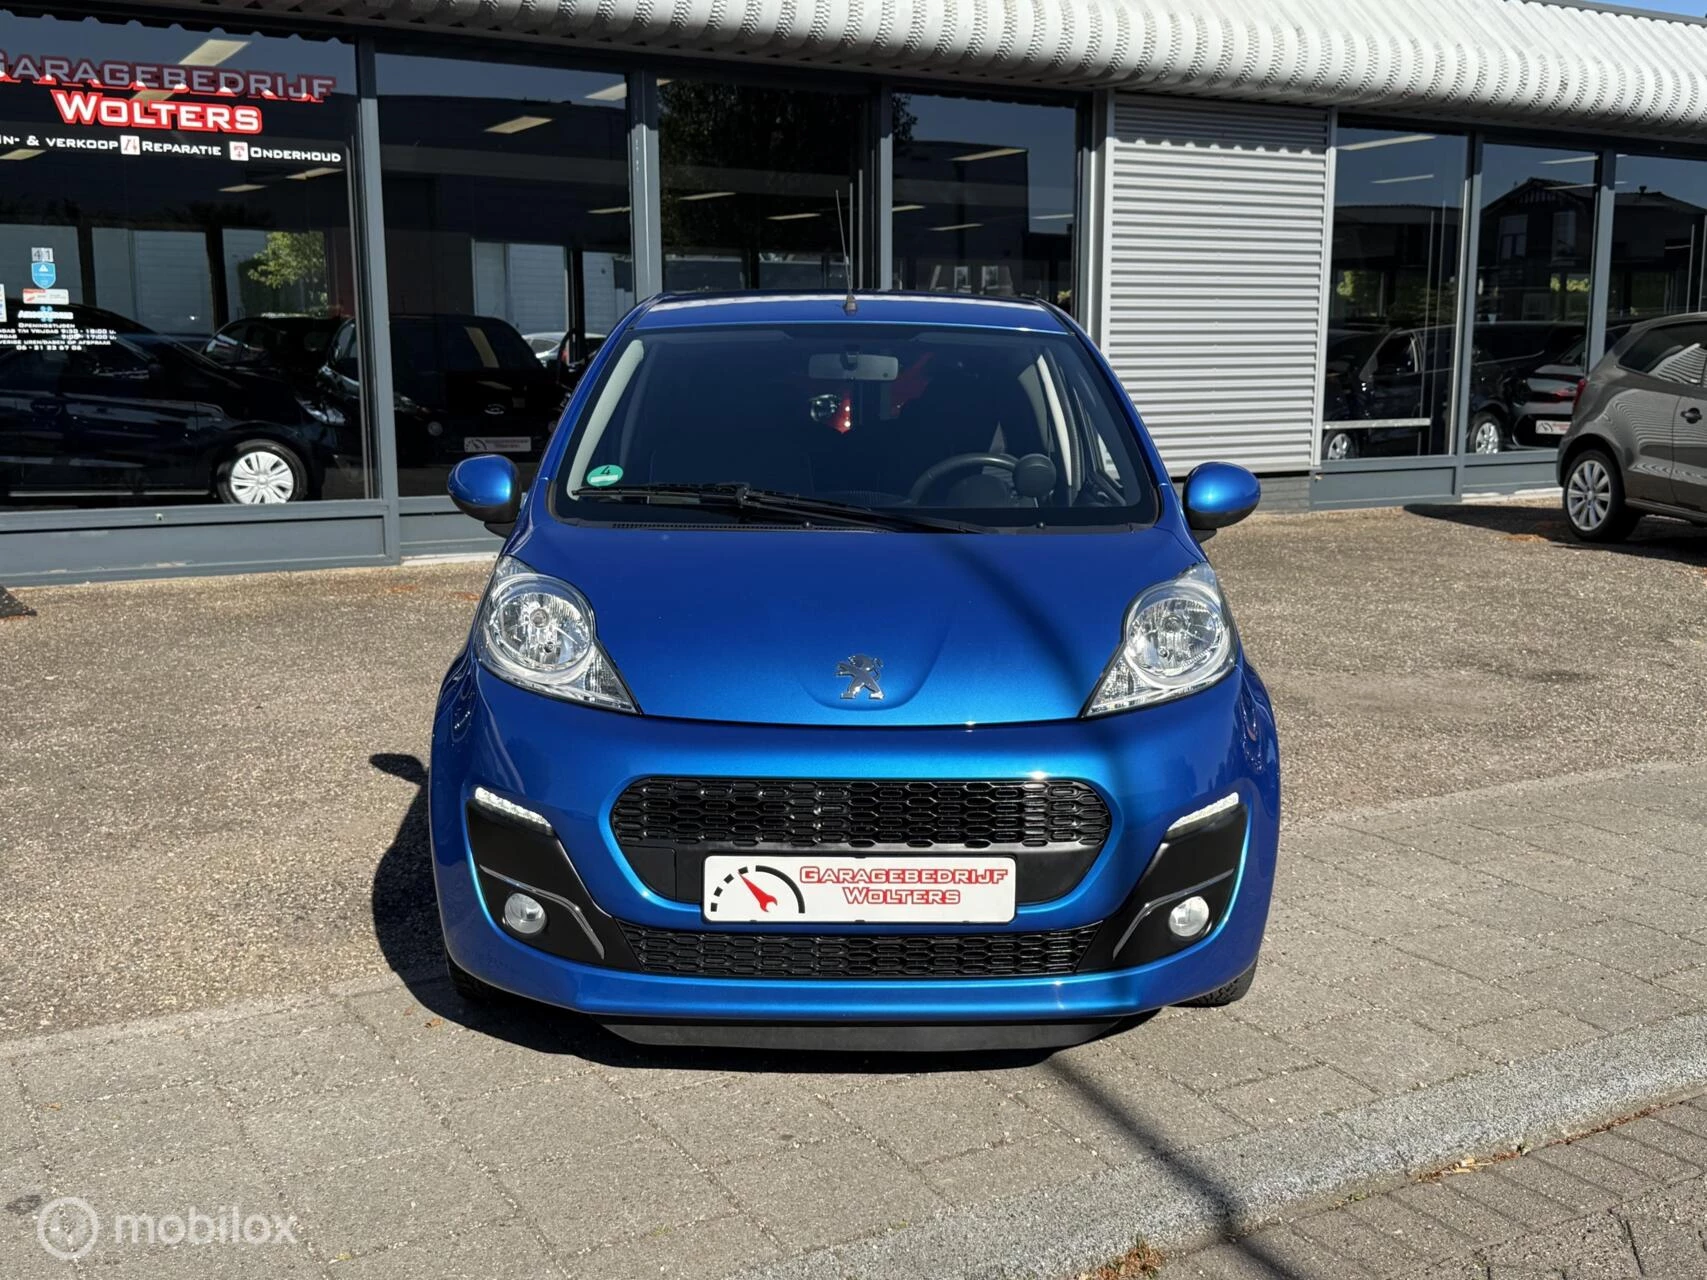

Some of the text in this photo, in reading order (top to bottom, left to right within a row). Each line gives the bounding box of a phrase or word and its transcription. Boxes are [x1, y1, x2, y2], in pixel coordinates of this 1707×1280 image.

[0, 50, 335, 102] ARAGEBEDRIJF
[51, 89, 262, 134] WOLTERS
[27, 135, 40, 146] &
[45, 137, 118, 150] VERKOOP
[142, 141, 222, 156] REPARATIE
[250, 147, 342, 162] ONDERHOUD
[600, 464, 611, 476] 4
[799, 866, 1009, 885] GARAGEBEDRIJF
[842, 886, 961, 905] WOLTERS
